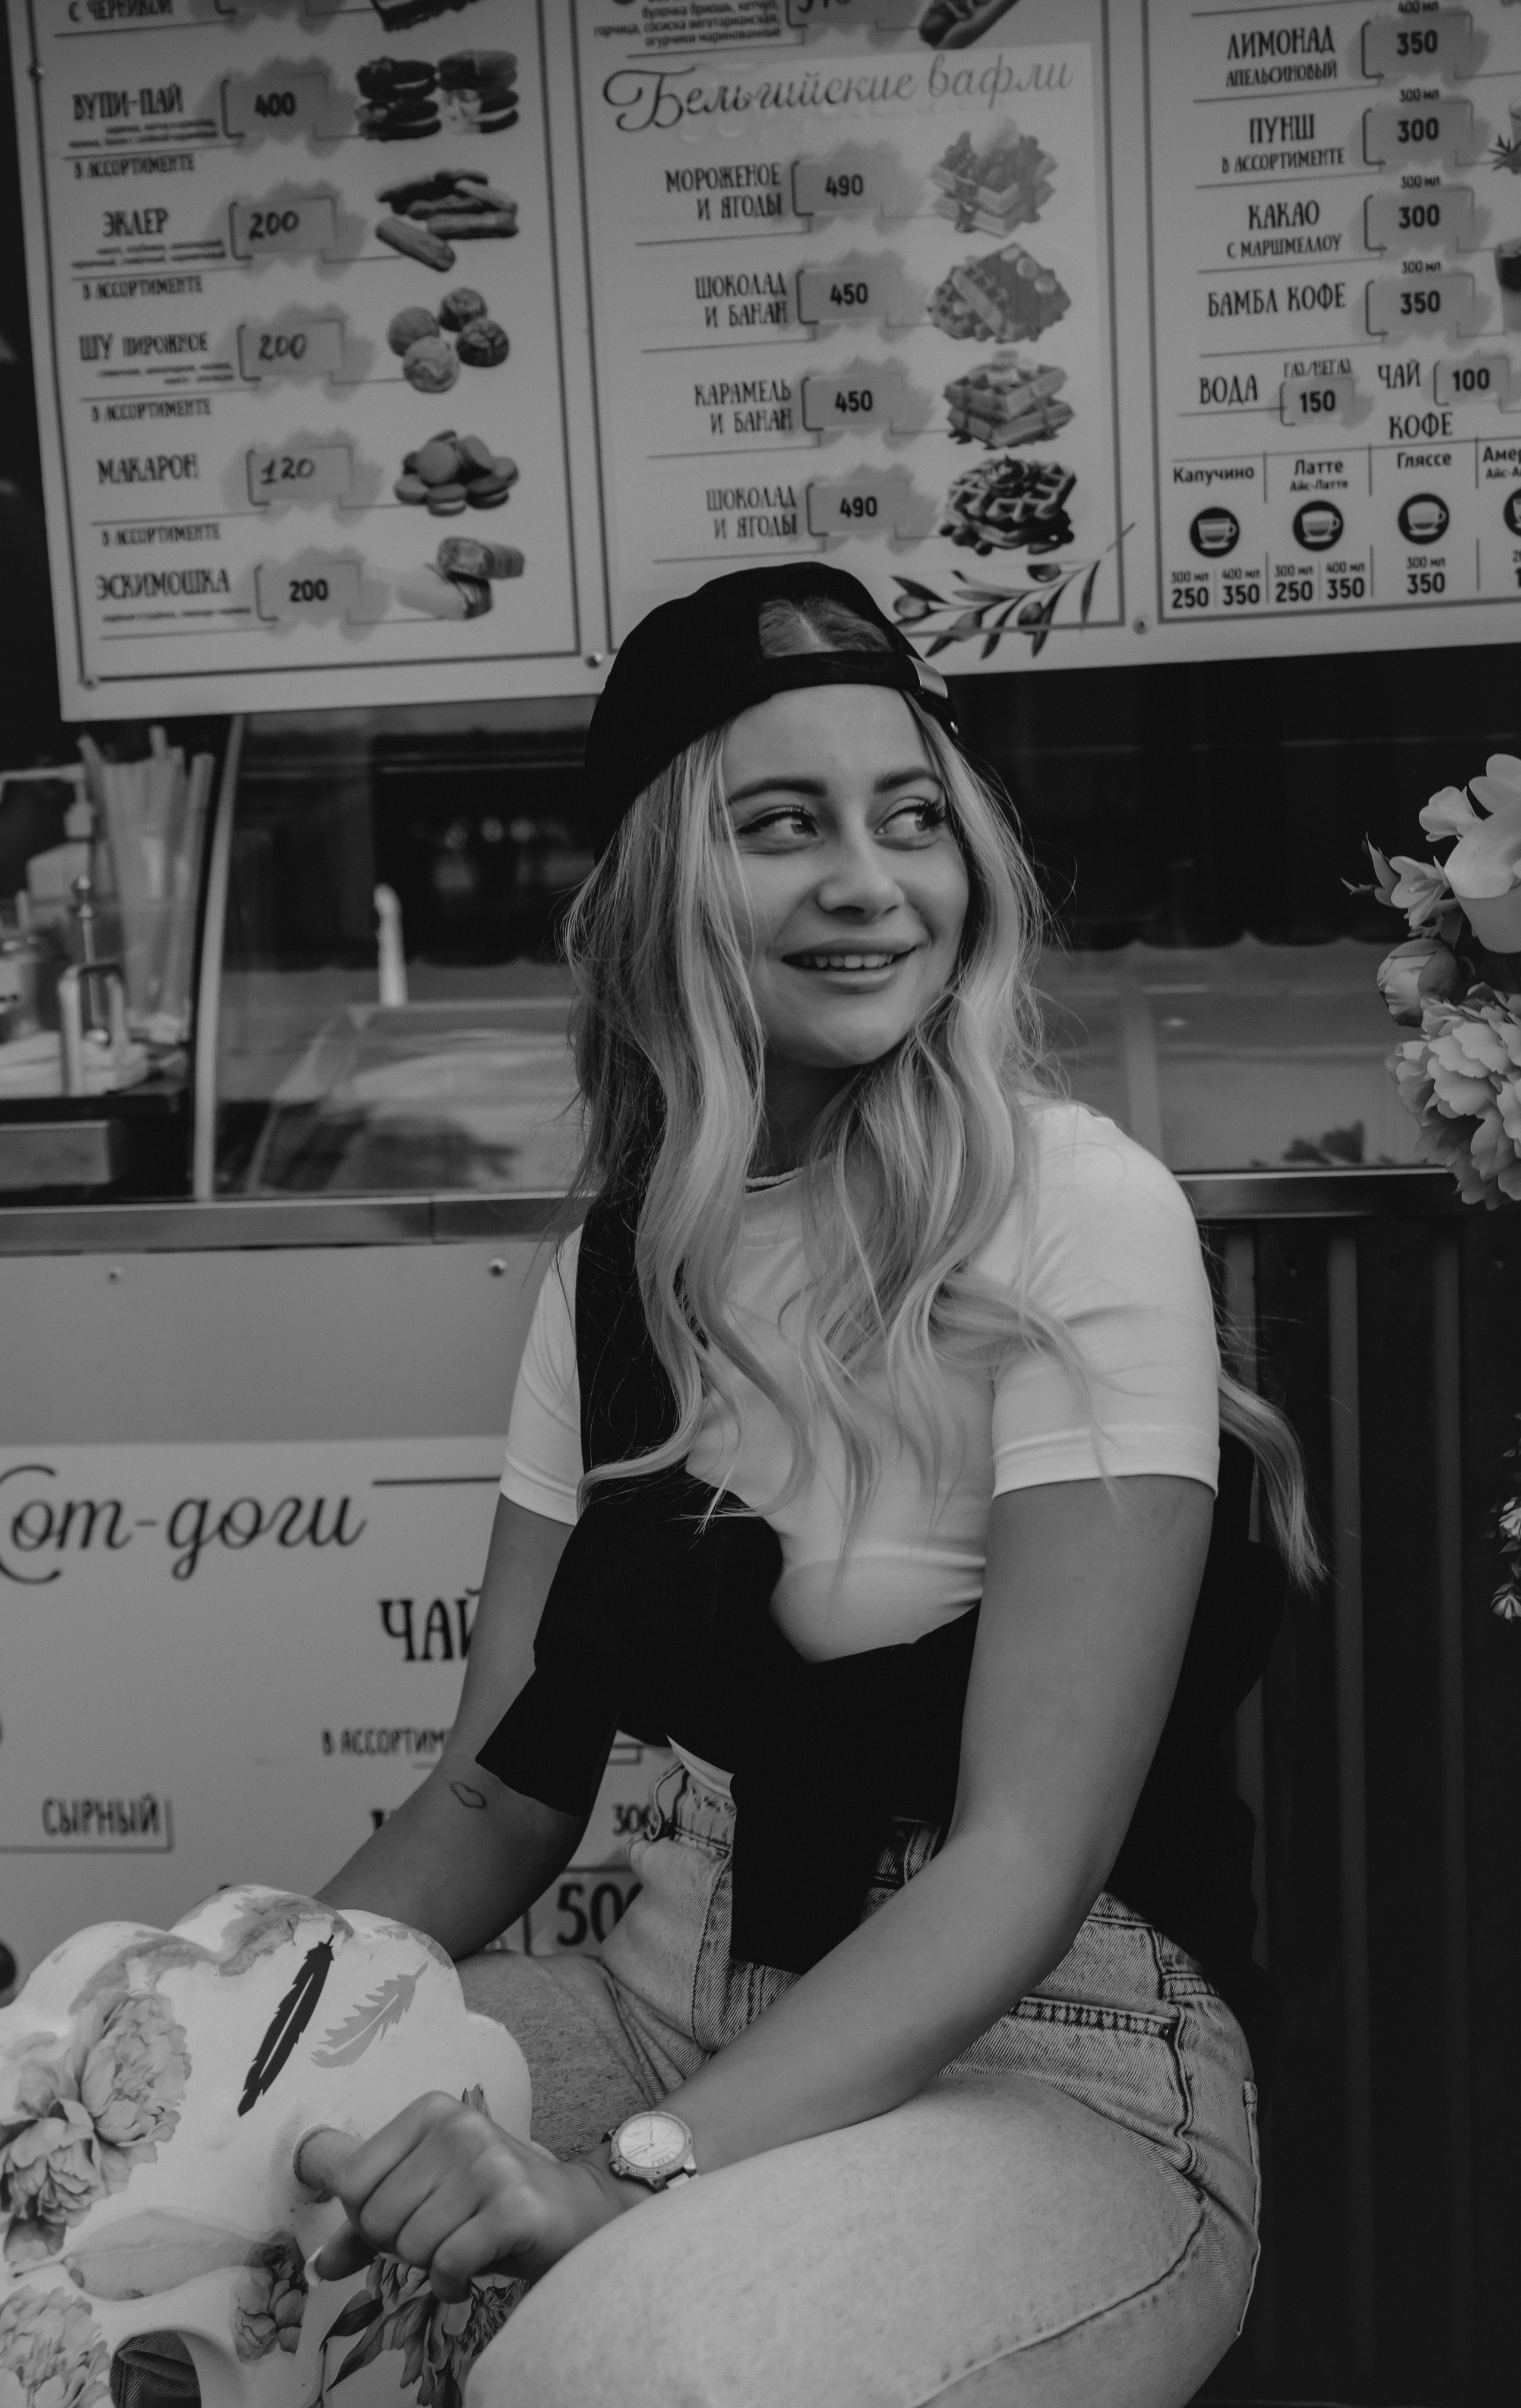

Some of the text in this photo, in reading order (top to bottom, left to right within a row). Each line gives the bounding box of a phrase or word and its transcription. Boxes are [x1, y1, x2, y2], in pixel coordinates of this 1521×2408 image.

[1227, 25, 1336, 61] ЛИМОНАД
[1396, 30, 1438, 56] 350
[1225, 59, 1338, 87] АПЕЛЬСИНОВЫЙ
[254, 90, 297, 118] 400
[602, 52, 1072, 132] Бельгийские вафли
[1400, 89, 1421, 103] 300
[1248, 113, 1315, 144] ПУНШ
[1397, 117, 1440, 144] 300
[1222, 146, 1345, 174] В АССОРТИМЕНТЕ
[664, 162, 781, 193] МОРОЖЕНОЕ
[825, 173, 864, 197] 490
[1400, 175, 1421, 188] 300
[697, 193, 782, 221] И ЯГОДЫ
[1248, 200, 1320, 231] КАКАО
[1398, 203, 1441, 230] 300
[102, 207, 169, 238] ЭКЛЕР
[248, 210, 300, 241] 200
[1227, 234, 1342, 259] С МАРШМЕЛЛОУ
[1401, 261, 1422, 274] 300
[95, 275, 202, 300] АССОРТИМЕНТЕ
[695, 272, 787, 300] ШОКОЛАД
[829, 282, 869, 305] 450
[1207, 282, 1346, 318] БАМБЛ КОФЕ
[1400, 289, 1441, 316] 350
[705, 301, 787, 328] И БАНАН
[78, 331, 208, 361] ШУ ПИРОЖНОЕ
[258, 333, 307, 361] 200
[1377, 358, 1422, 390] ЧАЙ
[1451, 367, 1490, 392] 100
[694, 379, 793, 407] КАРАМЕЛЬ
[835, 390, 873, 412] 450
[1199, 373, 1259, 406] ВОДА
[1298, 388, 1337, 414] 150
[103, 398, 212, 423] АССОРТИМЕНТЕ
[710, 407, 793, 434] И БАНАН
[1389, 411, 1454, 440] КОФЕ
[96, 453, 200, 486] МАКАРОН
[259, 455, 316, 485] 120
[1293, 458, 1345, 477] Латте
[1396, 451, 1452, 470] Гляссе
[1173, 465, 1255, 487] Капучино
[1289, 478, 1349, 493] Айс-Латте
[706, 485, 796, 512] ШОКОЛАД
[839, 496, 879, 518] 490
[115, 522, 220, 546] АССОРТИМЕНТЕ
[714, 513, 796, 540] И ЯГОДЫ
[1221, 567, 1243, 581] 400
[1274, 564, 1296, 578] 300
[1325, 560, 1347, 574] 400
[1406, 556, 1427, 570] 300
[96, 568, 231, 600] ЭСКИМОШКА
[289, 578, 329, 603] 200
[1170, 571, 1192, 584] 300
[1326, 576, 1365, 600] 350
[1406, 571, 1446, 595] 350
[1171, 586, 1210, 610] 250
[1222, 582, 1261, 606] 350
[1274, 580, 1314, 604] 250
[40, 1791, 162, 1838] СЫРНЫЙ
[556, 1881, 643, 1947] 50
